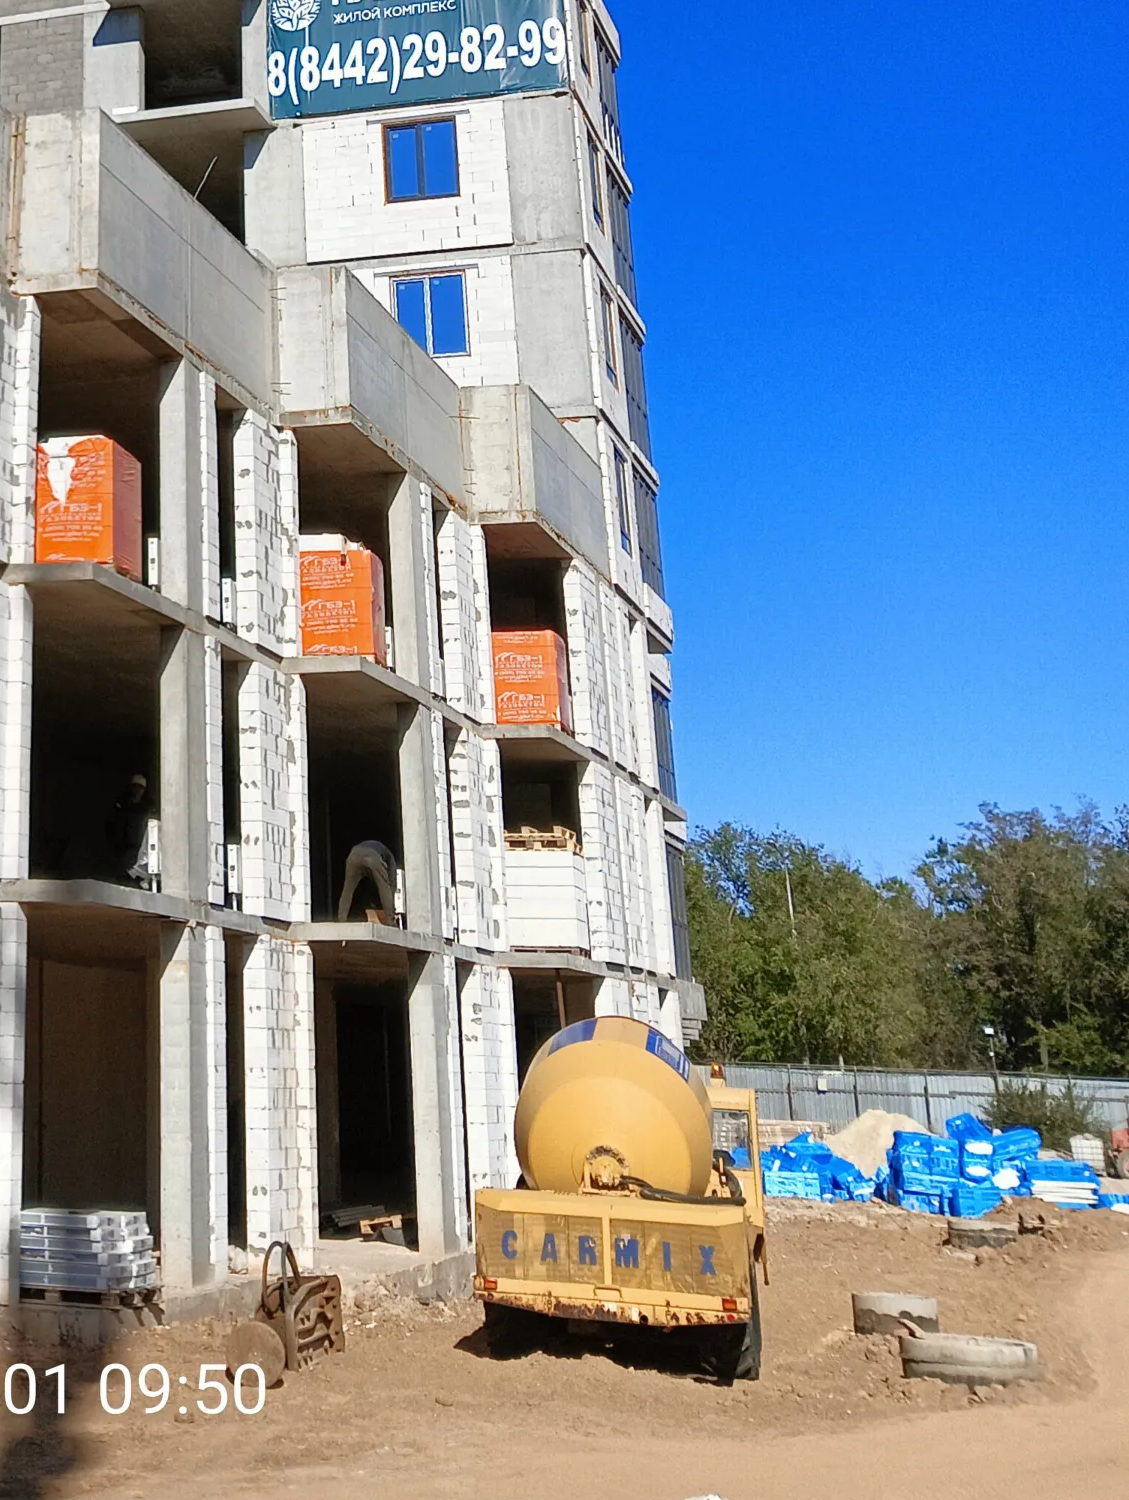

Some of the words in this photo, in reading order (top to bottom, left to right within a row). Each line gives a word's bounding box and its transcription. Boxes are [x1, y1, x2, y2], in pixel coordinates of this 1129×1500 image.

[333, 7, 382, 25] ЖИЛОЙ
[268, 16, 566, 106] 8(8442)29-82-99
[501, 1230, 717, 1276] CARMIX
